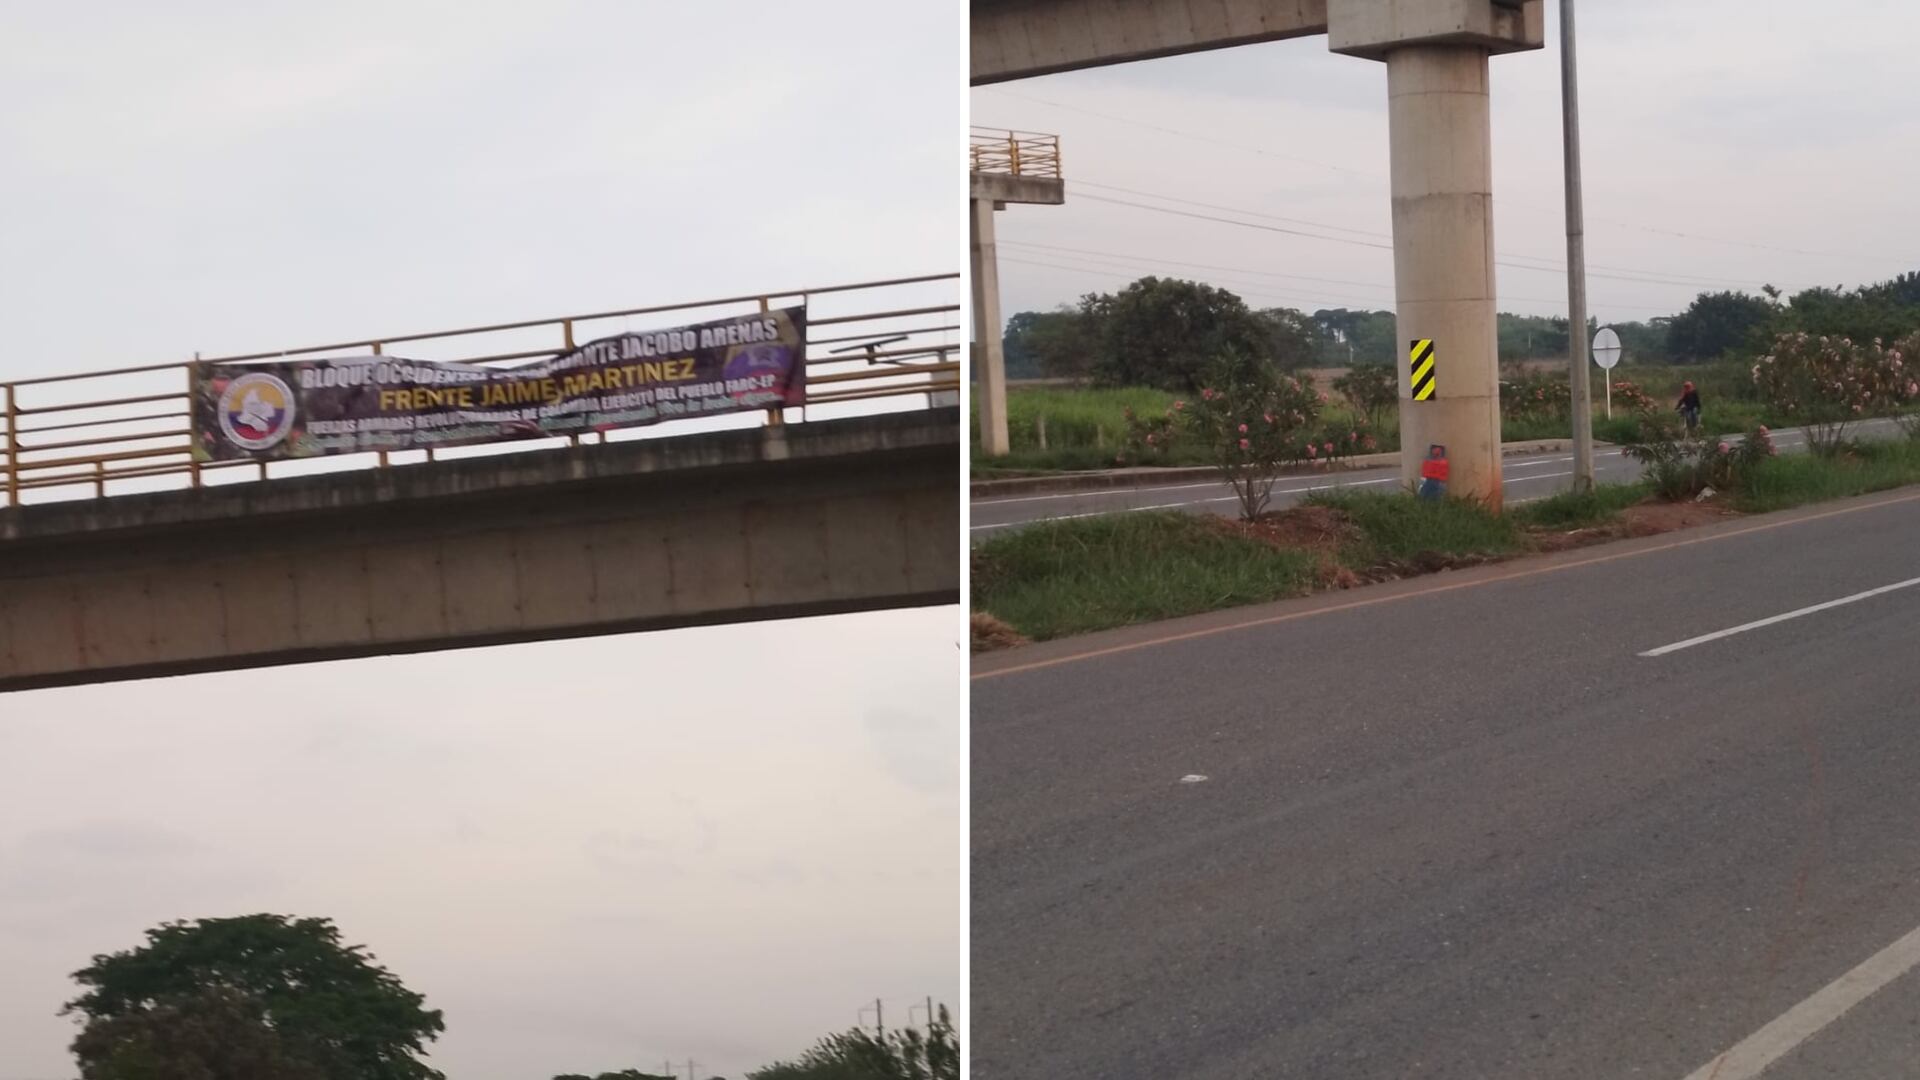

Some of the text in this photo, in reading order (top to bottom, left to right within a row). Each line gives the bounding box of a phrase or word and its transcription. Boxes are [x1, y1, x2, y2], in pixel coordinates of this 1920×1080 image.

[301, 364, 374, 389] BLOQUE
[377, 363, 488, 384] OCCIDEN
[621, 330, 697, 359] JACOBO
[701, 319, 778, 349] ARENAS
[380, 358, 697, 411] FRENTE JAIME MARTINEZ
[601, 390, 655, 410] EJERCITO
[655, 387, 678, 401] DEL
[678, 382, 725, 399] PUEBLO
[725, 374, 776, 393] FARC-EP
